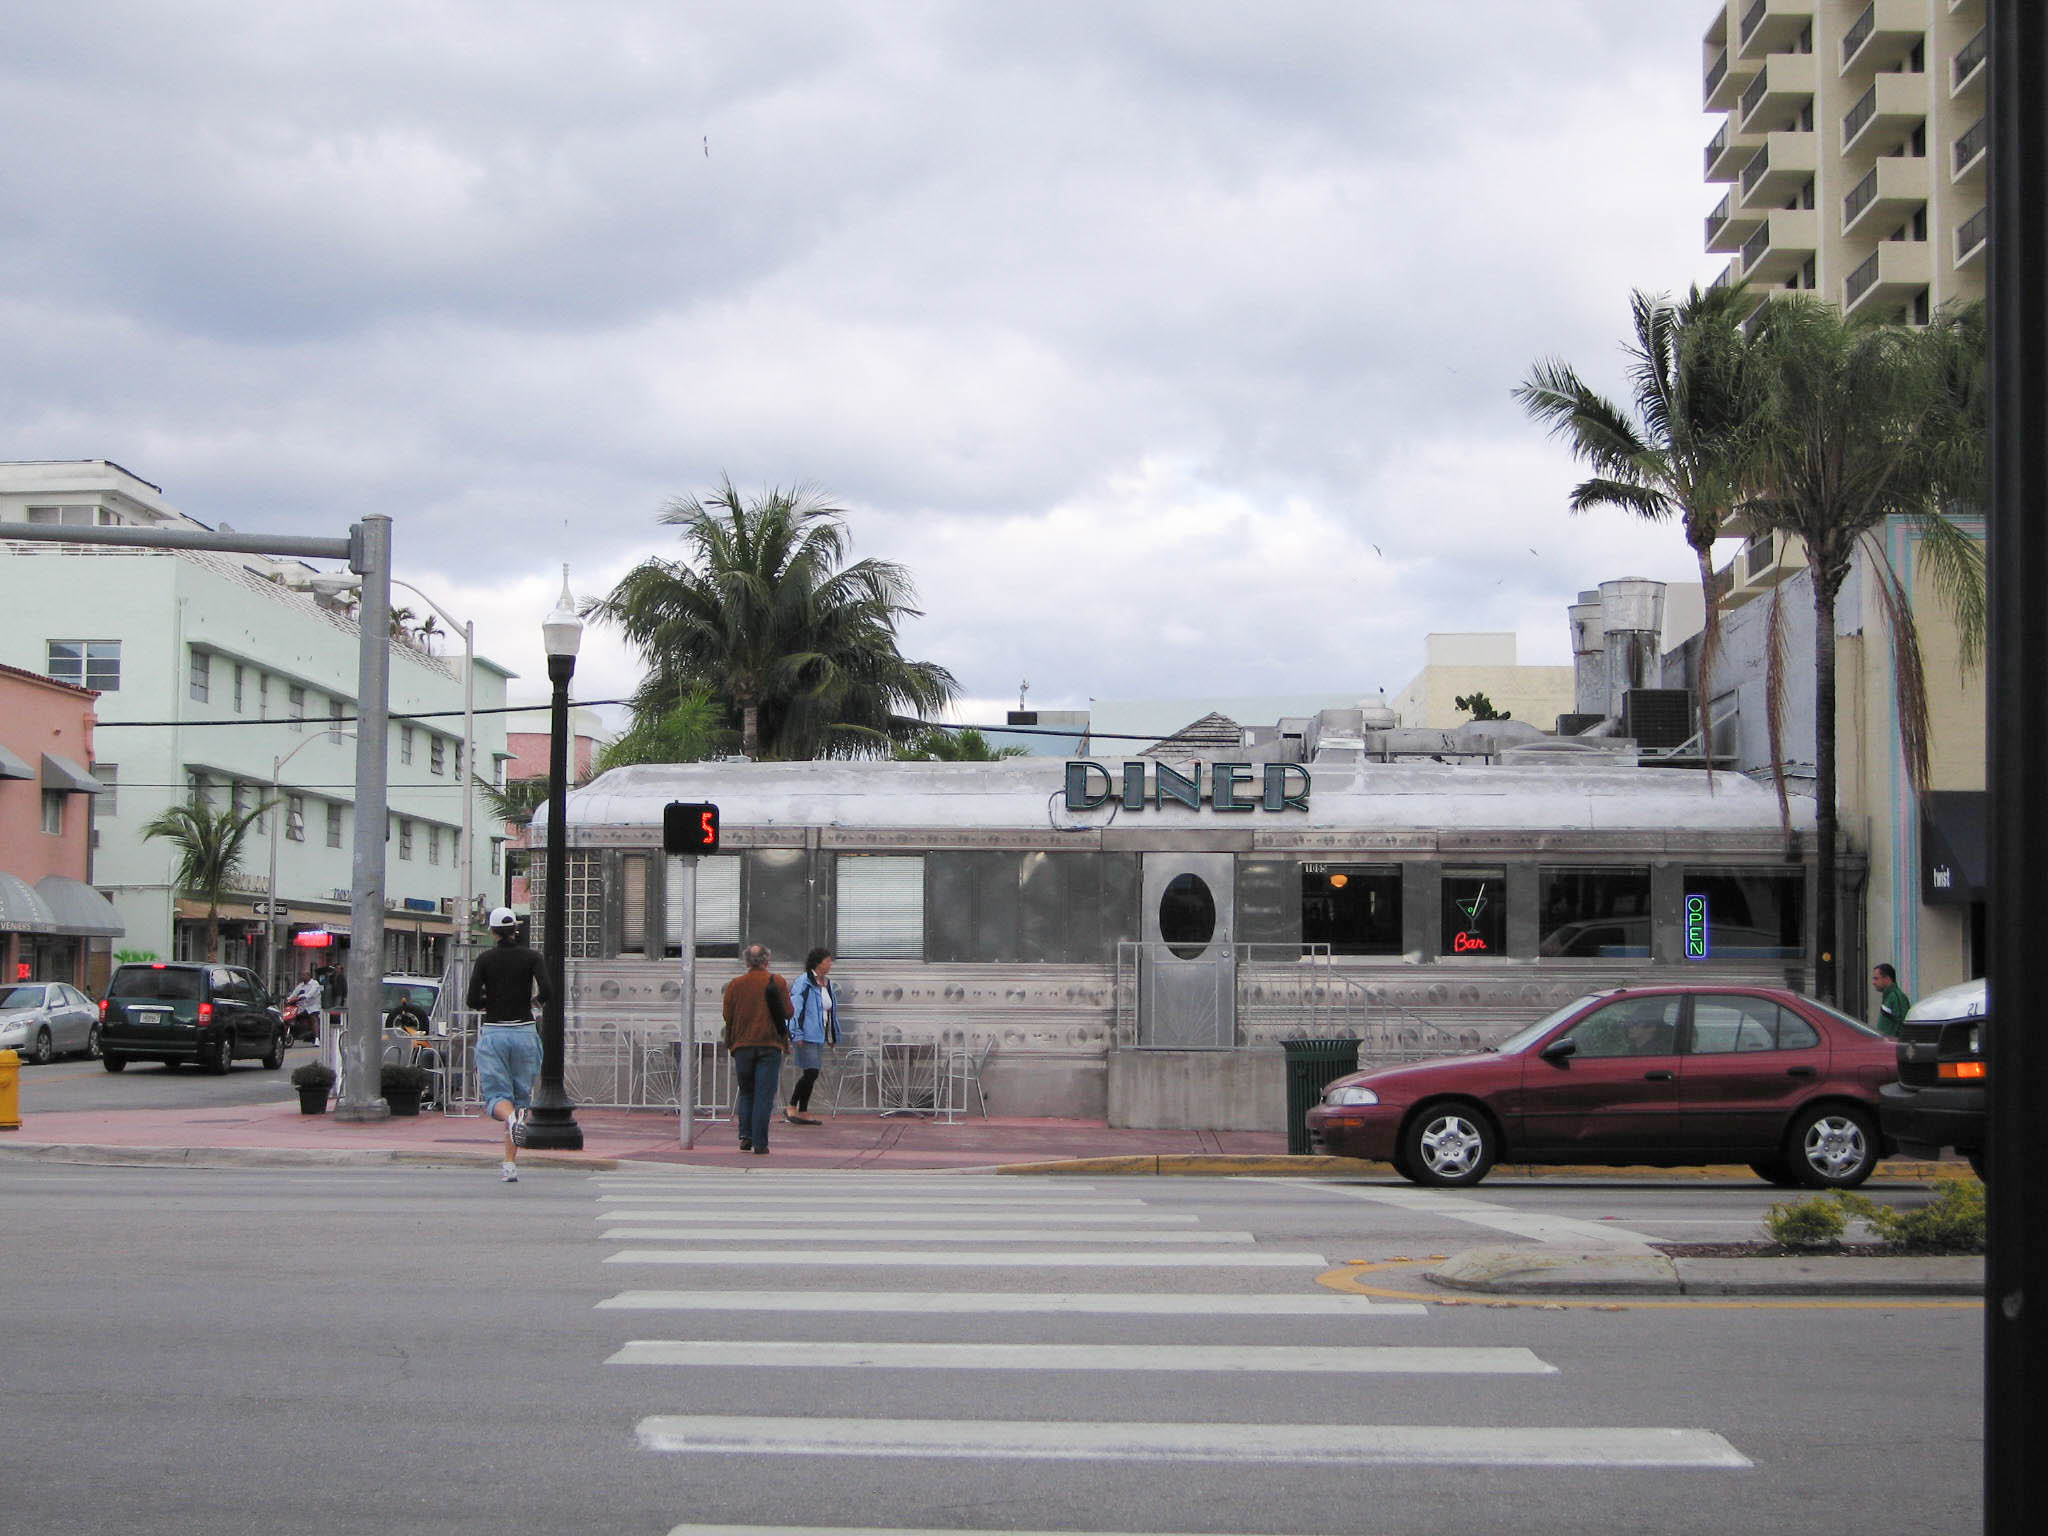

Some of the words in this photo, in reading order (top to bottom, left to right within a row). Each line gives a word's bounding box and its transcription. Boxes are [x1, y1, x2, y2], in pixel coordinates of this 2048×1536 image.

[1066, 762, 1312, 811] DINER
[702, 811, 715, 844] 5
[1454, 931, 1488, 952] Bar
[1688, 898, 1703, 955] OPEN
